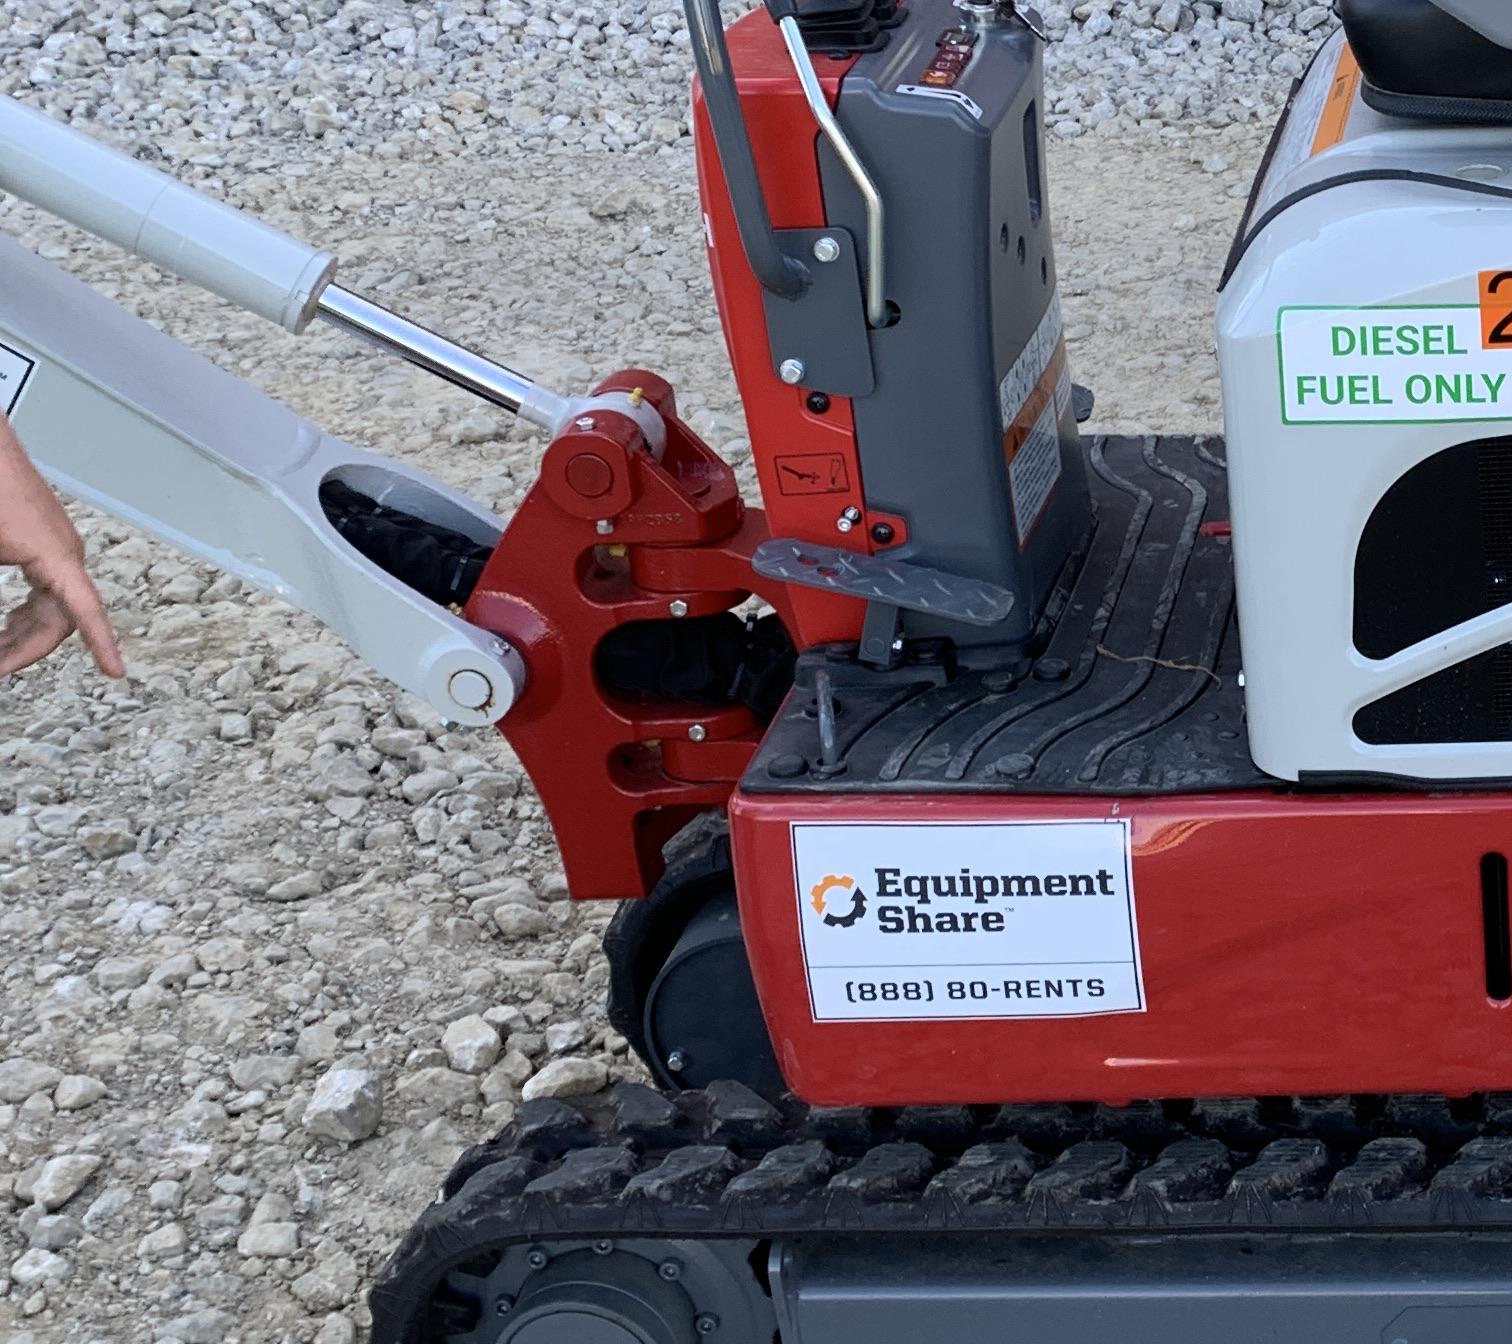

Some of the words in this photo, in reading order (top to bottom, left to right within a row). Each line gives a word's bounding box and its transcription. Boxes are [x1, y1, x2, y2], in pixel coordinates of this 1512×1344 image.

[1330, 324, 1467, 358] DIESEL
[1296, 372, 1393, 406] FUEL
[1403, 371, 1506, 405] ONLY
[874, 868, 1115, 905] Equipment
[845, 980, 934, 1003] (888)
[946, 978, 1105, 1000] 80-RENTS
